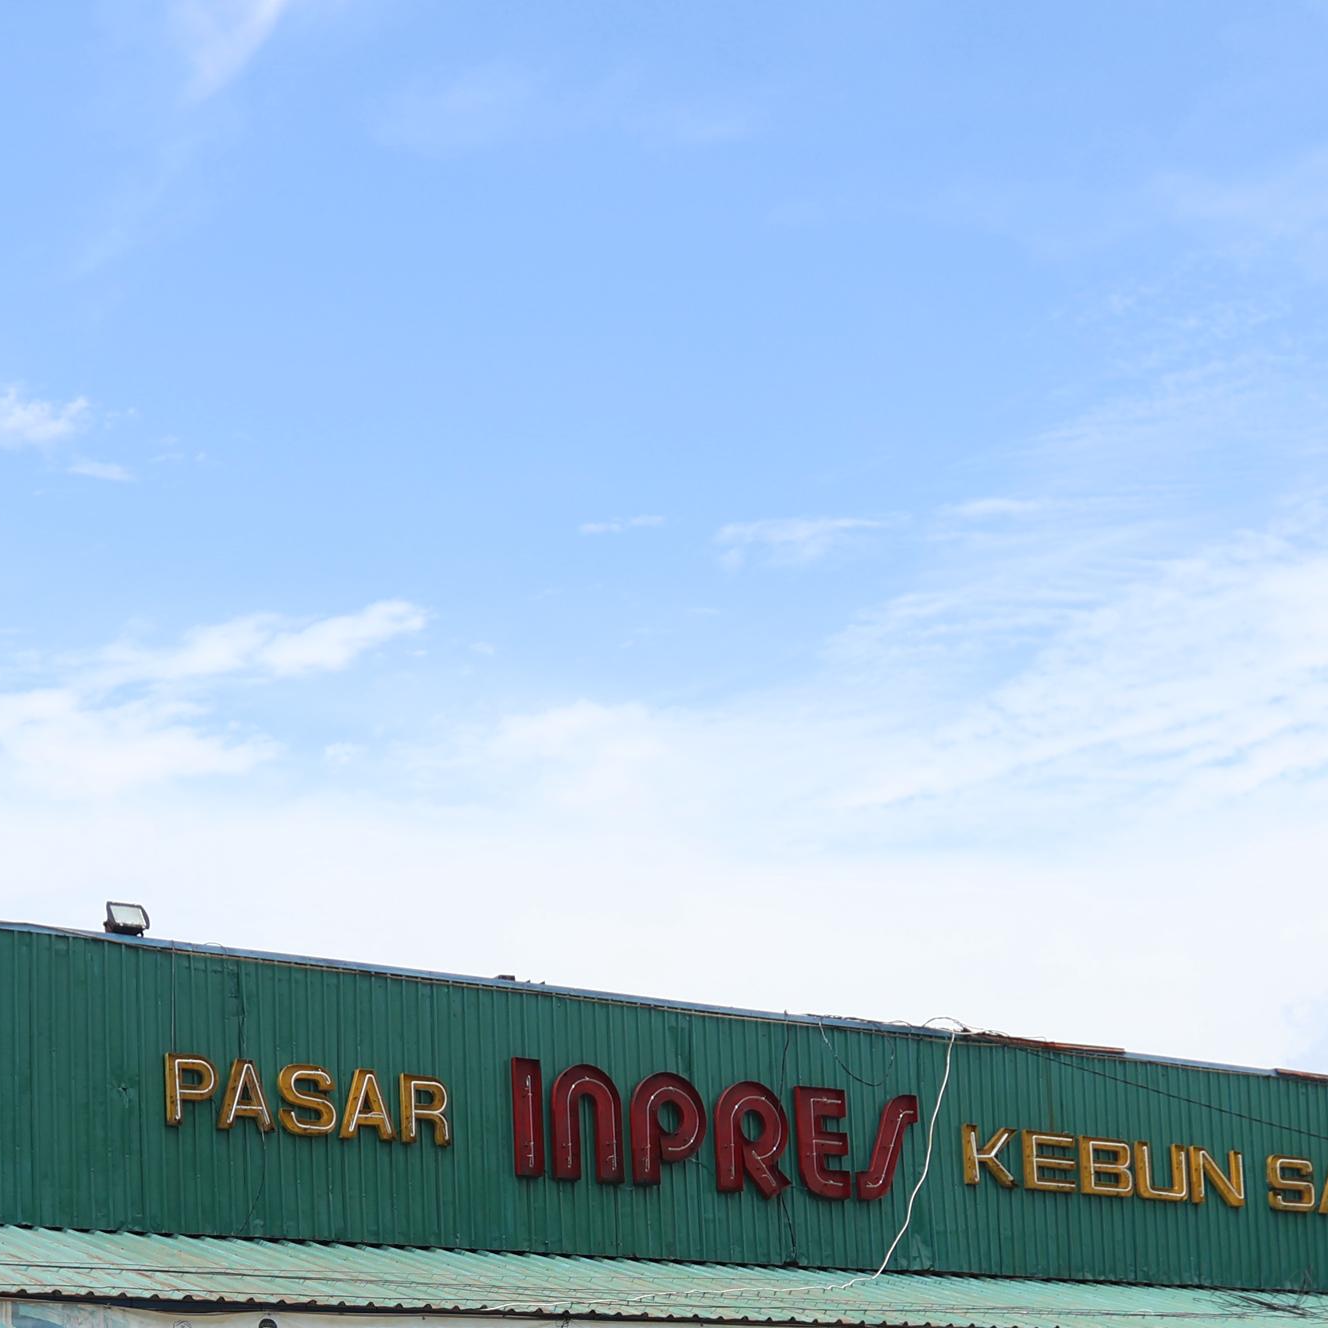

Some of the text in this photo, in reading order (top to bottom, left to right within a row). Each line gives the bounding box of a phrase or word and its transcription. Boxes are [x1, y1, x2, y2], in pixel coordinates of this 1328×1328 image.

[164, 1052, 452, 1147] PASAR
[510, 1057, 918, 1200] INPRES
[961, 1123, 1246, 1208] KEBUN
